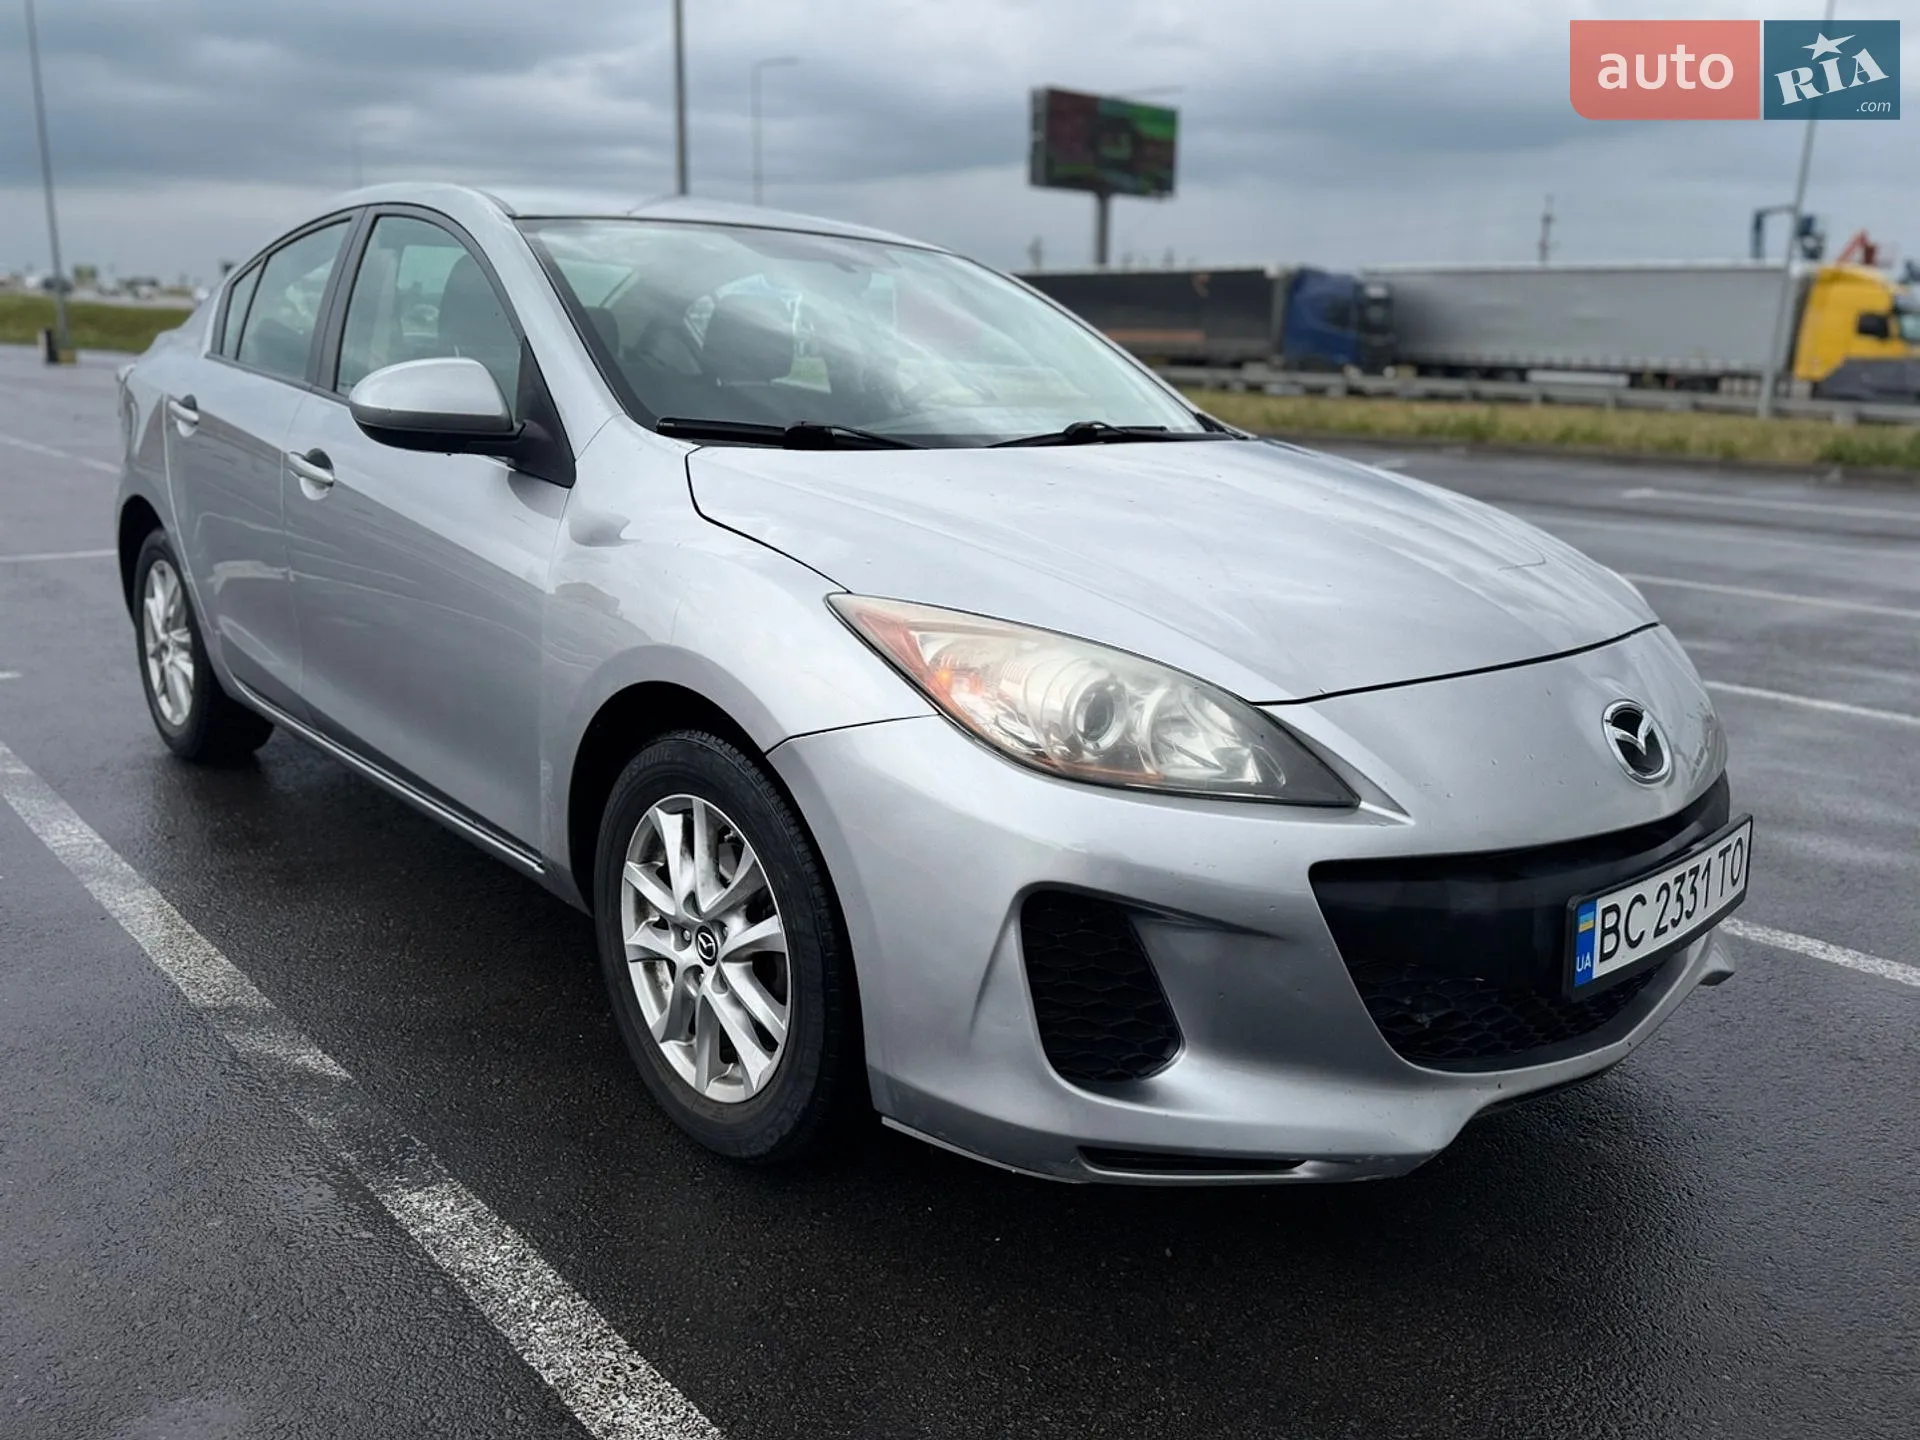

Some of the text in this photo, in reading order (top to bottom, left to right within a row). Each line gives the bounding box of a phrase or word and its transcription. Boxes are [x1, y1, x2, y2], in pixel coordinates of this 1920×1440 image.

[1599, 836, 1744, 963] BC 2331 TO
[1575, 952, 1592, 972] UA
